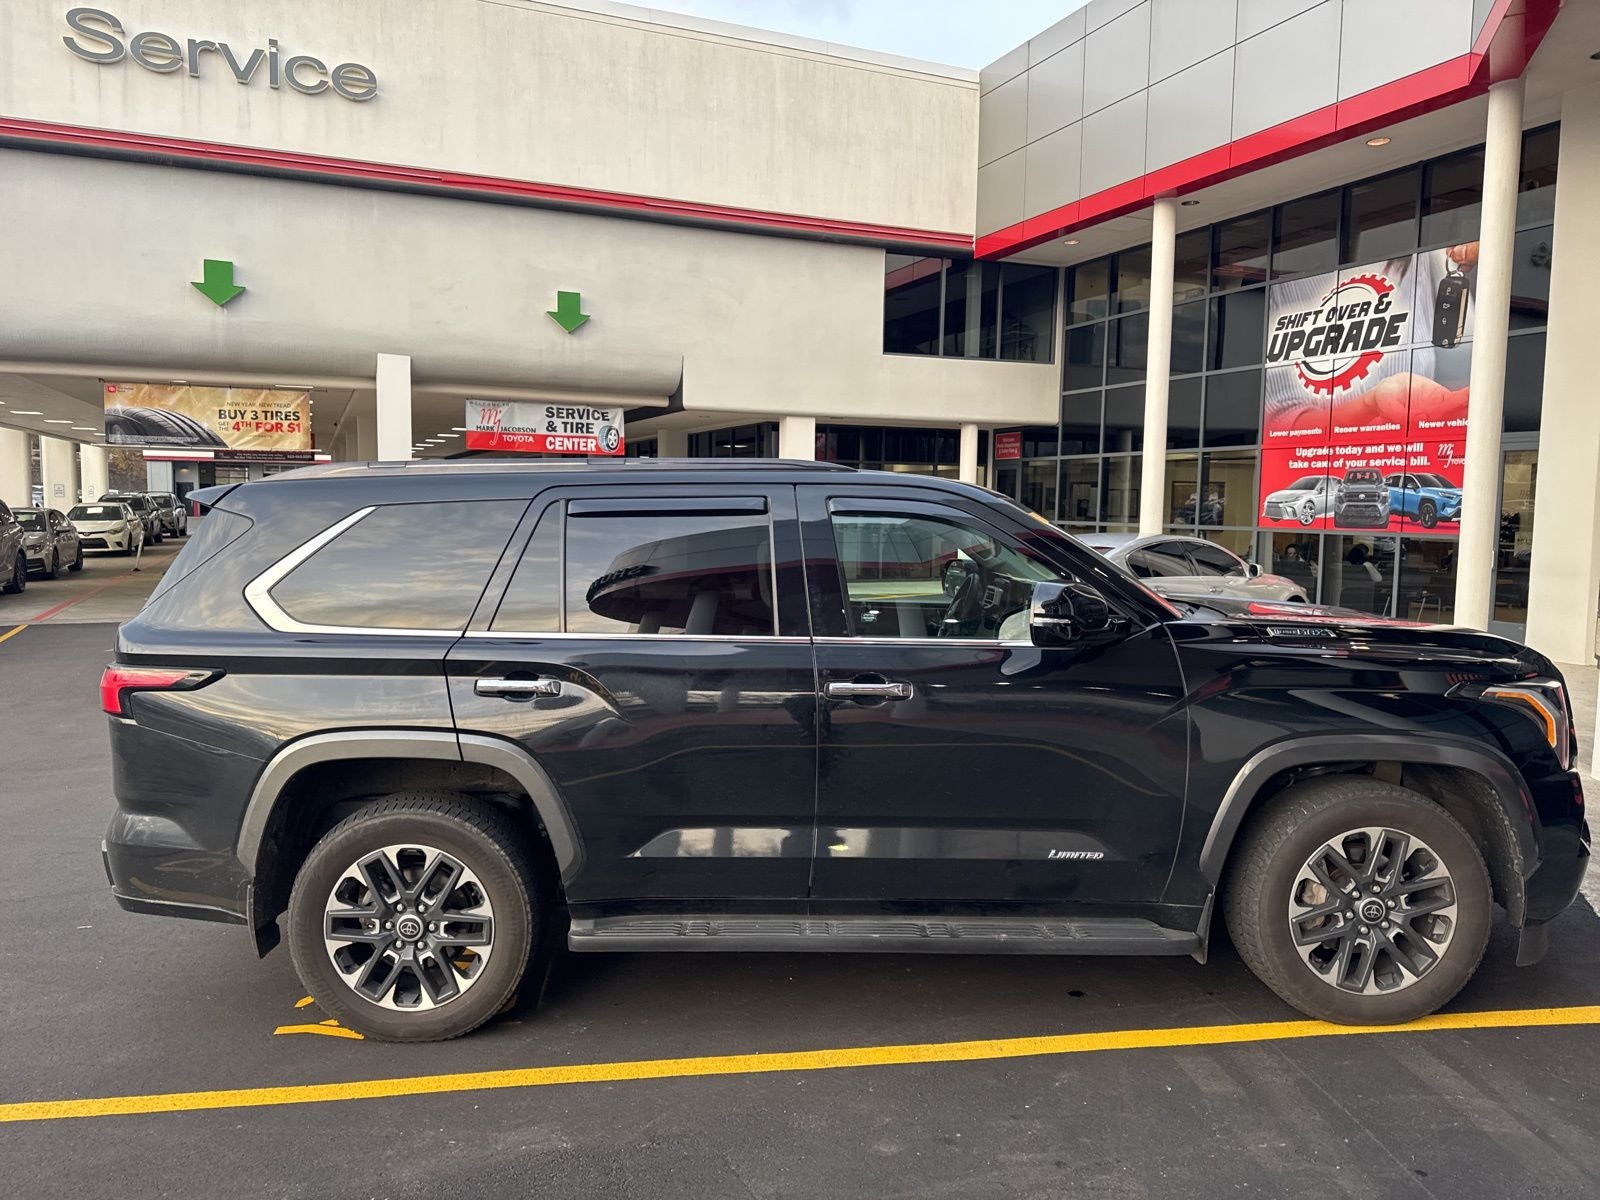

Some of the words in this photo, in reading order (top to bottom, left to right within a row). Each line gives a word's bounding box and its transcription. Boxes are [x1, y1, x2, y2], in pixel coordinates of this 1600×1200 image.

[62, 7, 378, 102] Service
[1275, 309, 1324, 331] SHIFT
[1325, 301, 1372, 323] OVER
[1374, 292, 1393, 315] &
[1266, 312, 1409, 362] UPGRADE
[218, 409, 247, 420] BUY
[250, 410, 259, 420] 3
[262, 410, 301, 421] TIRES
[545, 406, 610, 421] SERVICE
[232, 421, 252, 432] 4TH
[255, 422, 285, 433] FOR
[287, 421, 302, 433] $1
[545, 421, 558, 432] &
[561, 421, 595, 434] TIRE
[1360, 422, 1401, 432] warranties
[1418, 420, 1445, 429] Newer
[1446, 418, 1469, 427] vehic
[502, 434, 535, 443] TOYOTA
[1289, 427, 1322, 437] payments
[545, 436, 597, 452] CENTER
[1295, 445, 1334, 457] Upgrade
[1335, 444, 1363, 456] today
[1365, 443, 1385, 453] and
[1387, 444, 1402, 452] we
[1403, 442, 1424, 452] will
[1288, 460, 1310, 469] take
[1332, 458, 1345, 468] of
[1345, 459, 1368, 469] your
[1369, 456, 1407, 467] service
[1409, 455, 1431, 466] bill.
[1047, 849, 1105, 860] LIMITED
